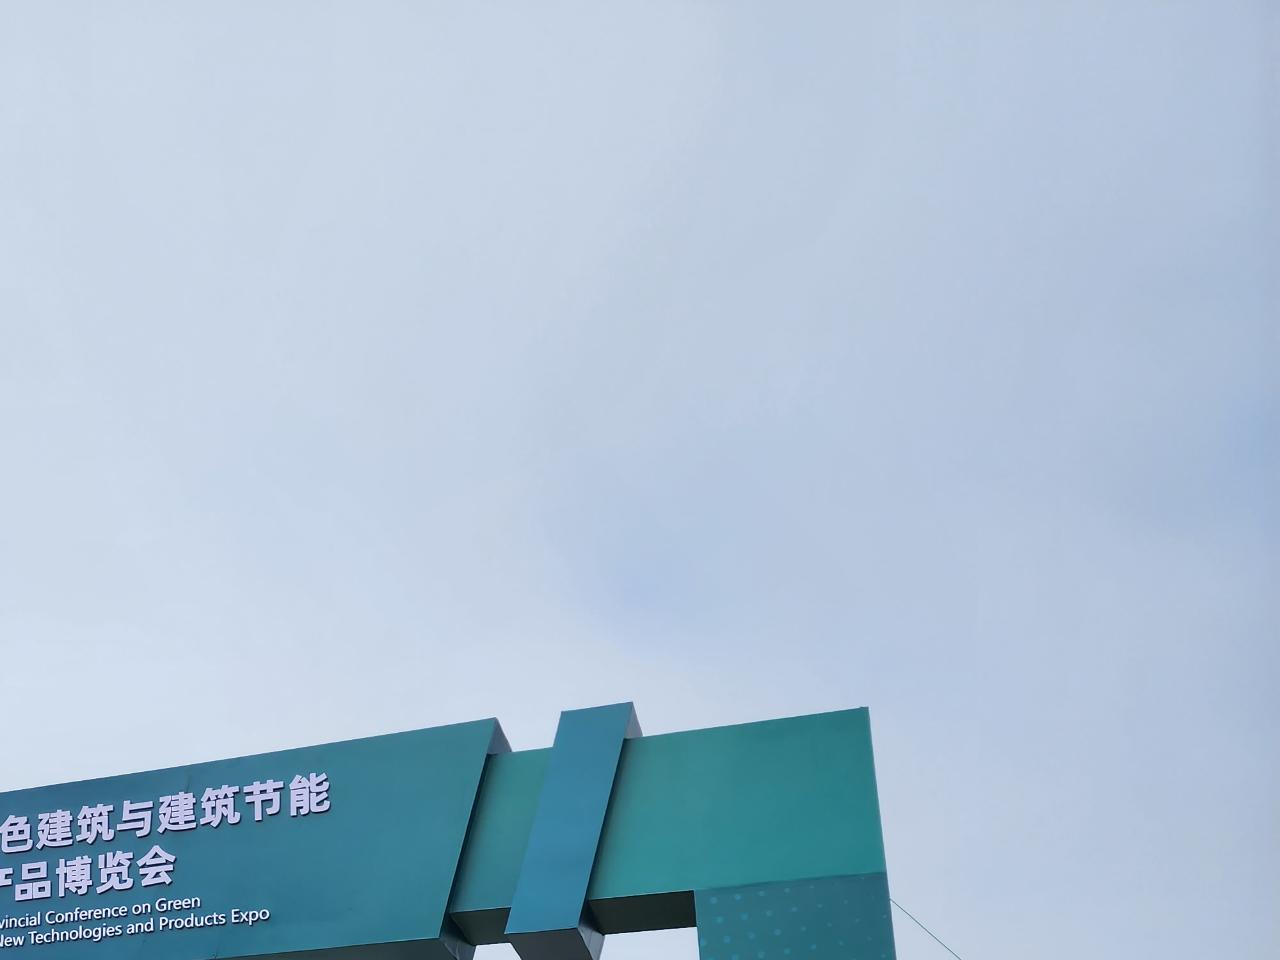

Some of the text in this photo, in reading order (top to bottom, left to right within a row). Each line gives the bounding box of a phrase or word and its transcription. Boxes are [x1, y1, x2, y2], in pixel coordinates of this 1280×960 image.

[46, 904, 128, 924] Conference
[132, 902, 151, 915] on
[155, 895, 201, 912] Green
[28, 922, 122, 946] Technologies
[126, 917, 154, 934] and
[159, 910, 226, 931] Products
[231, 908, 271, 926] Expo
